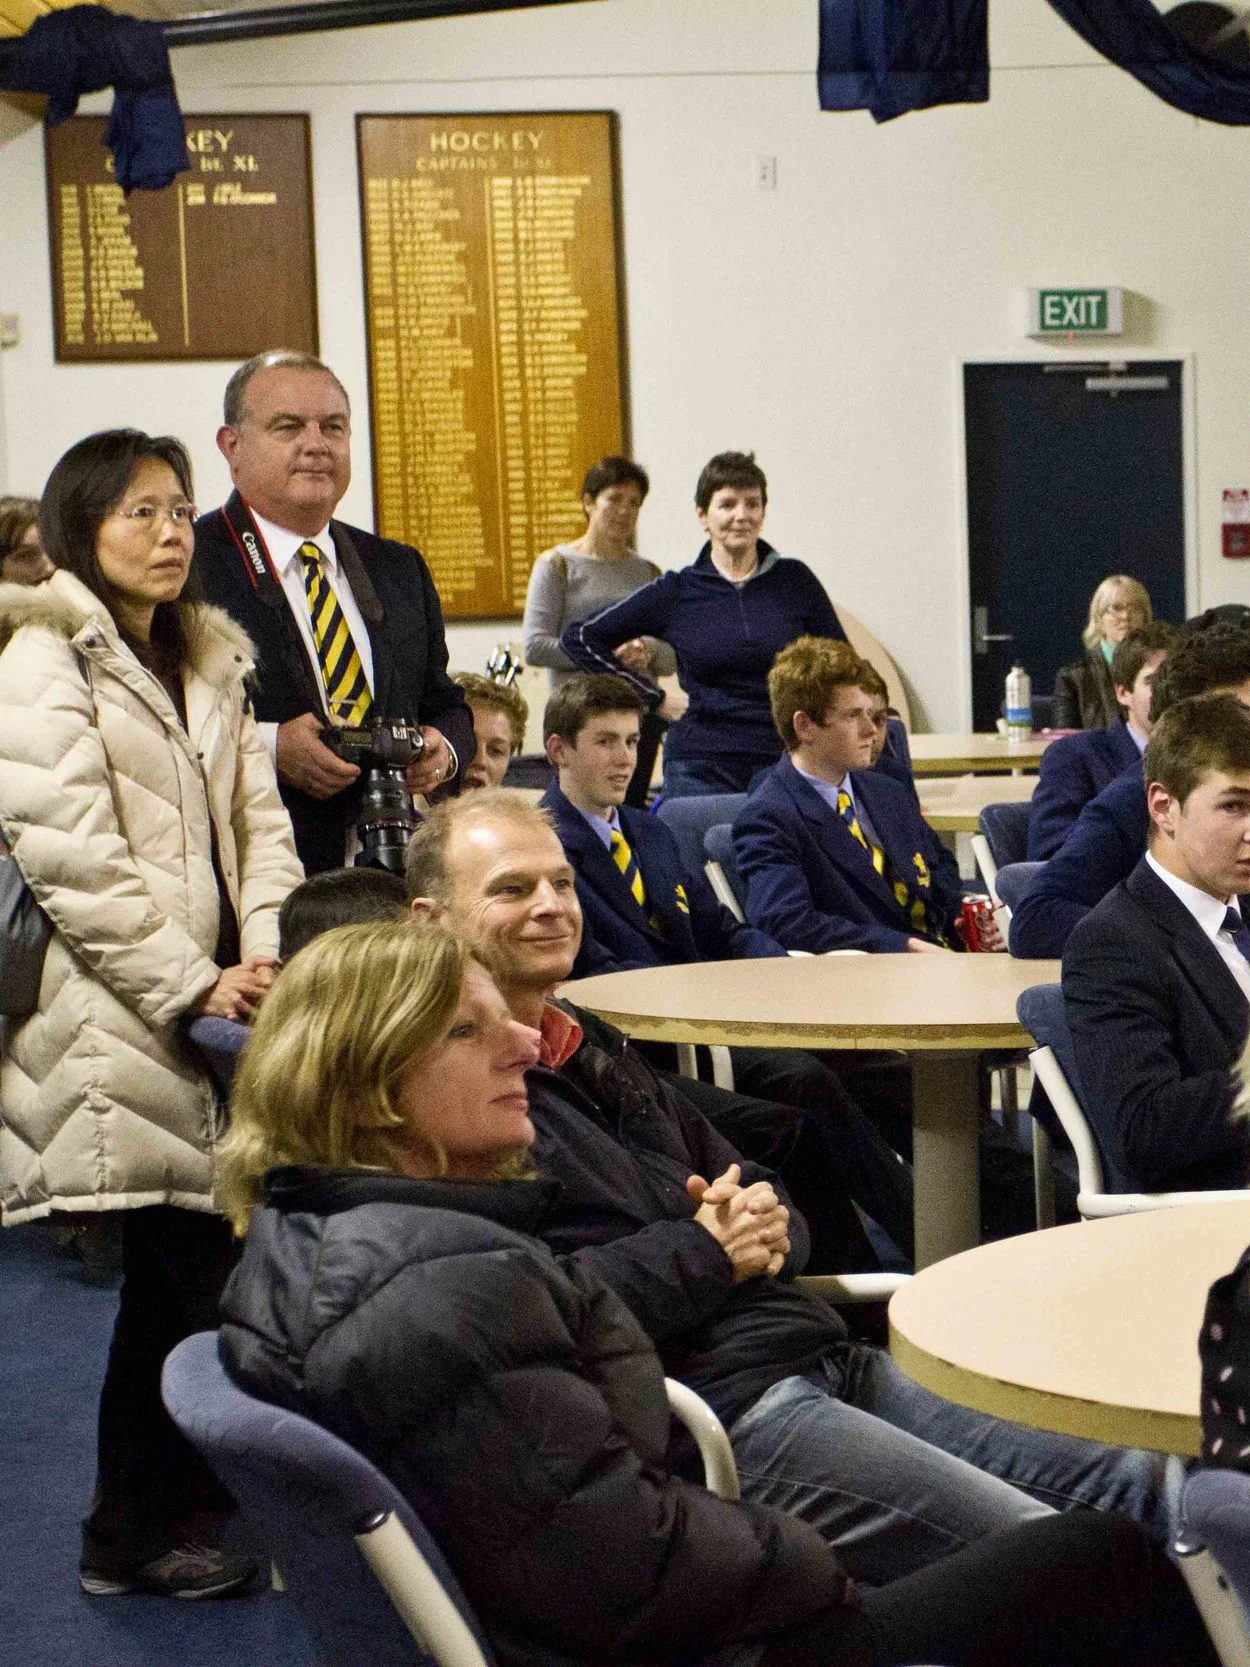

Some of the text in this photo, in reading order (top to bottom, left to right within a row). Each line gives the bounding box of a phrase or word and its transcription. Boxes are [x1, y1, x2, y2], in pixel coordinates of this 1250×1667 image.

[430, 130, 544, 151] HOCKEY
[415, 156, 498, 172] CAPTAINS
[1044, 295, 1101, 326] EXIT
[242, 531, 266, 574] Canon
